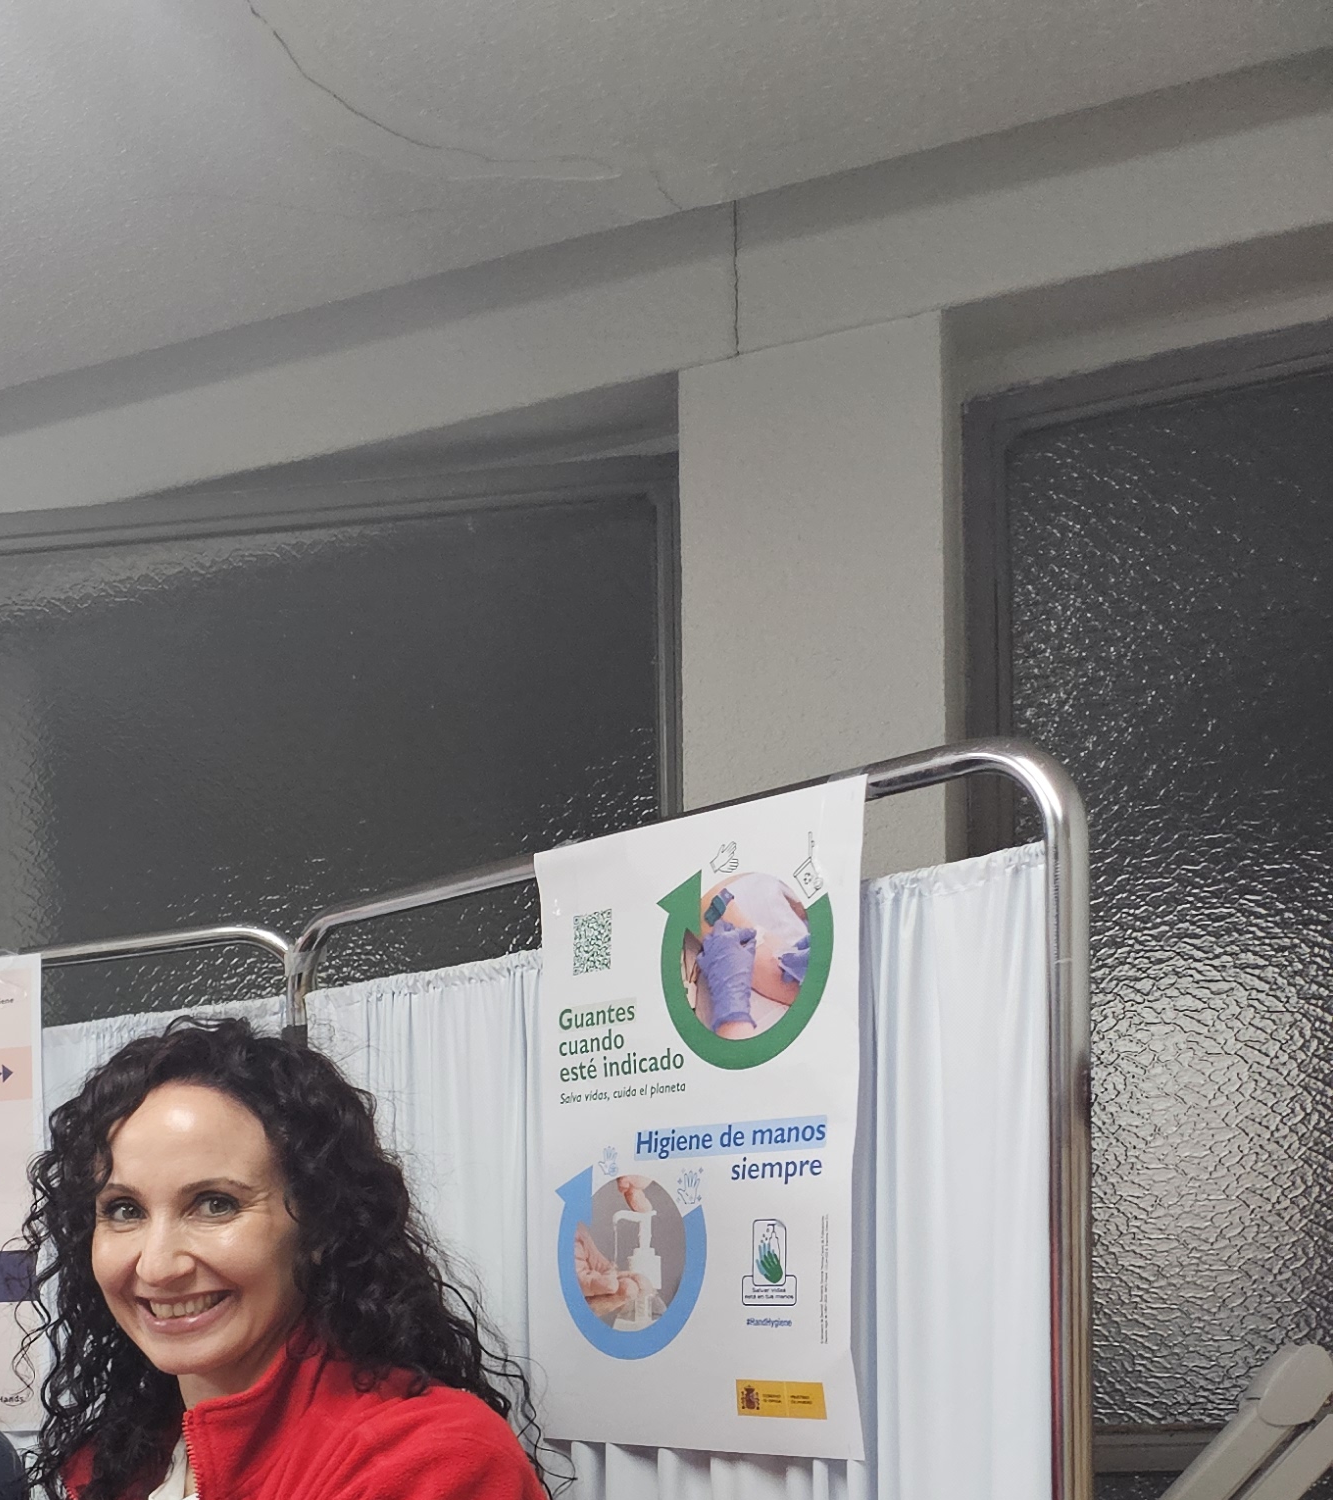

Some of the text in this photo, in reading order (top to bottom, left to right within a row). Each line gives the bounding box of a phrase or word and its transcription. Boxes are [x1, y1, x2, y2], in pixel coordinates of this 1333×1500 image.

[558, 1004, 635, 1031] Guantes
[558, 1028, 625, 1056] cuando
[559, 1047, 685, 1082] esté indicado
[559, 1082, 686, 1105] Salva vidas, cuida el planeta
[636, 1123, 827, 1159] Higiene de manos
[731, 1156, 823, 1185] siempre
